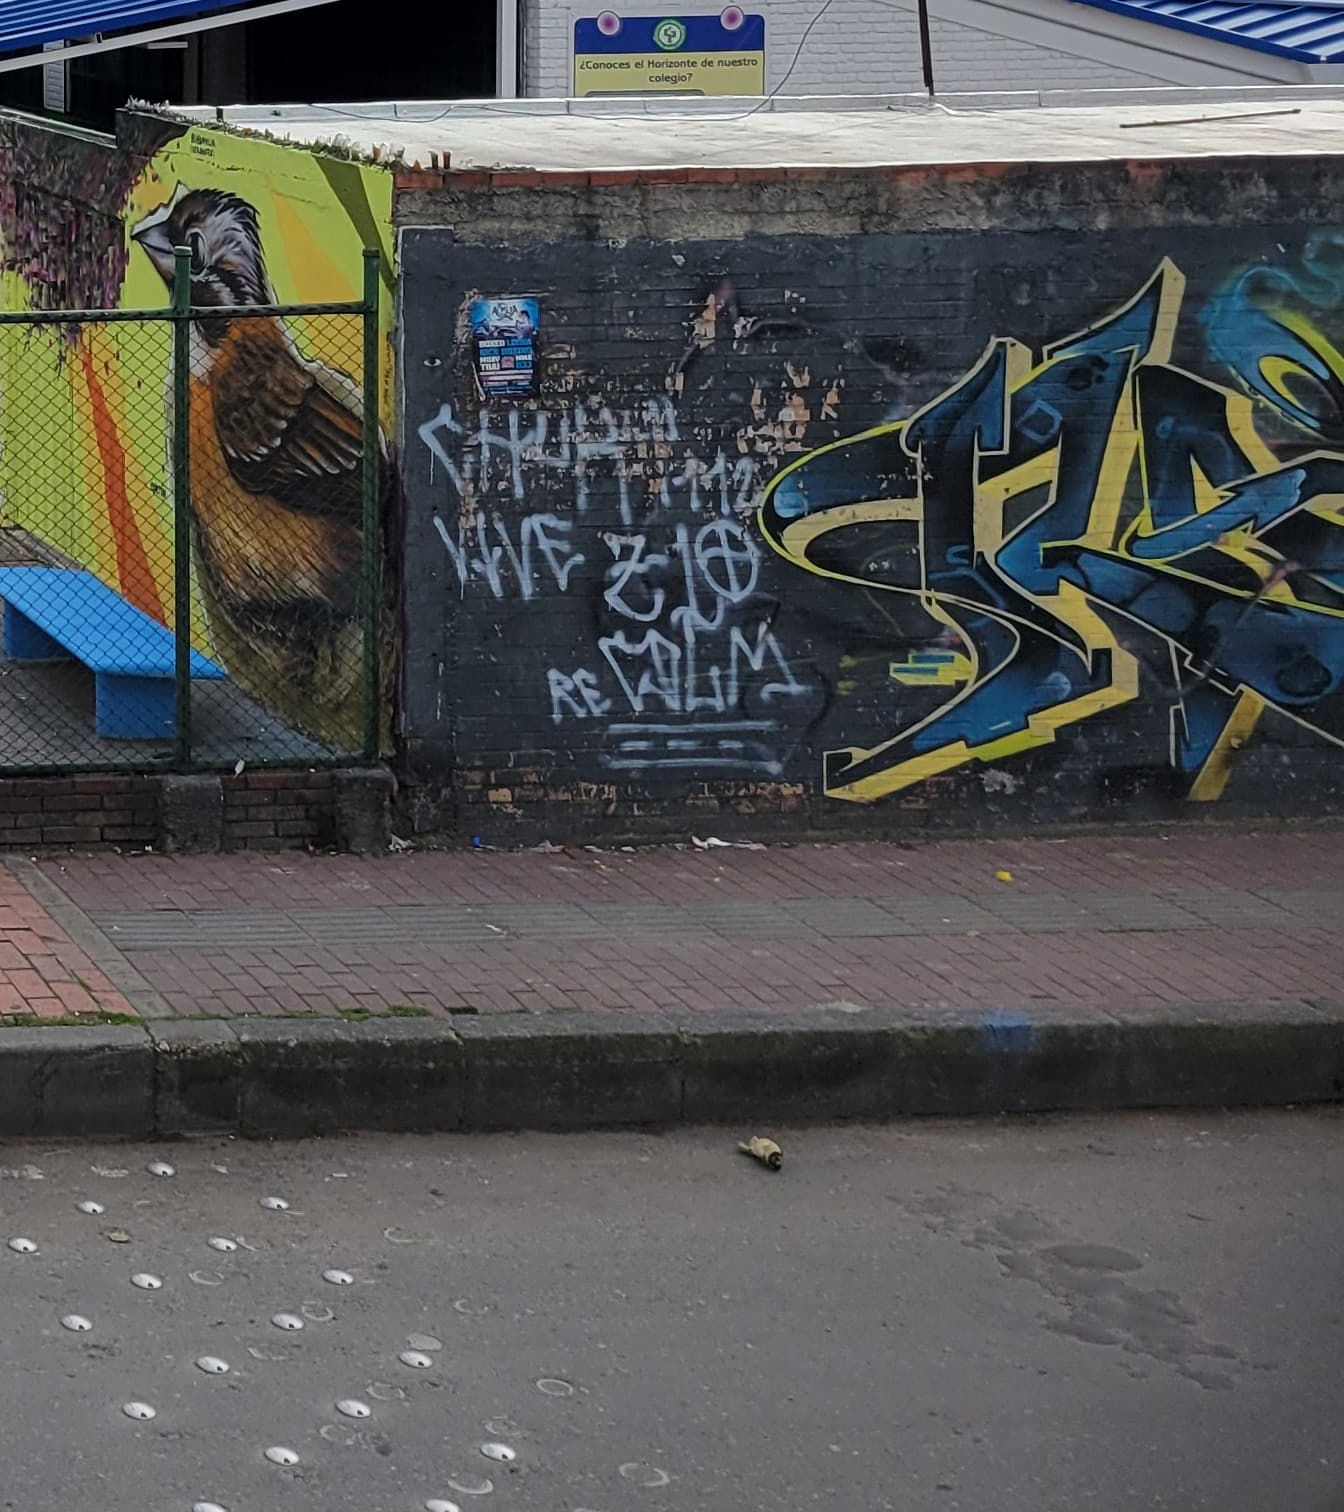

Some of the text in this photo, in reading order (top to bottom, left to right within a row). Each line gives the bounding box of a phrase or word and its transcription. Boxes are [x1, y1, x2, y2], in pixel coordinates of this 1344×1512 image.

[579, 57, 758, 71] ¿Conoces el Horizonte de nuestro
[648, 72, 693, 85] colegio?
